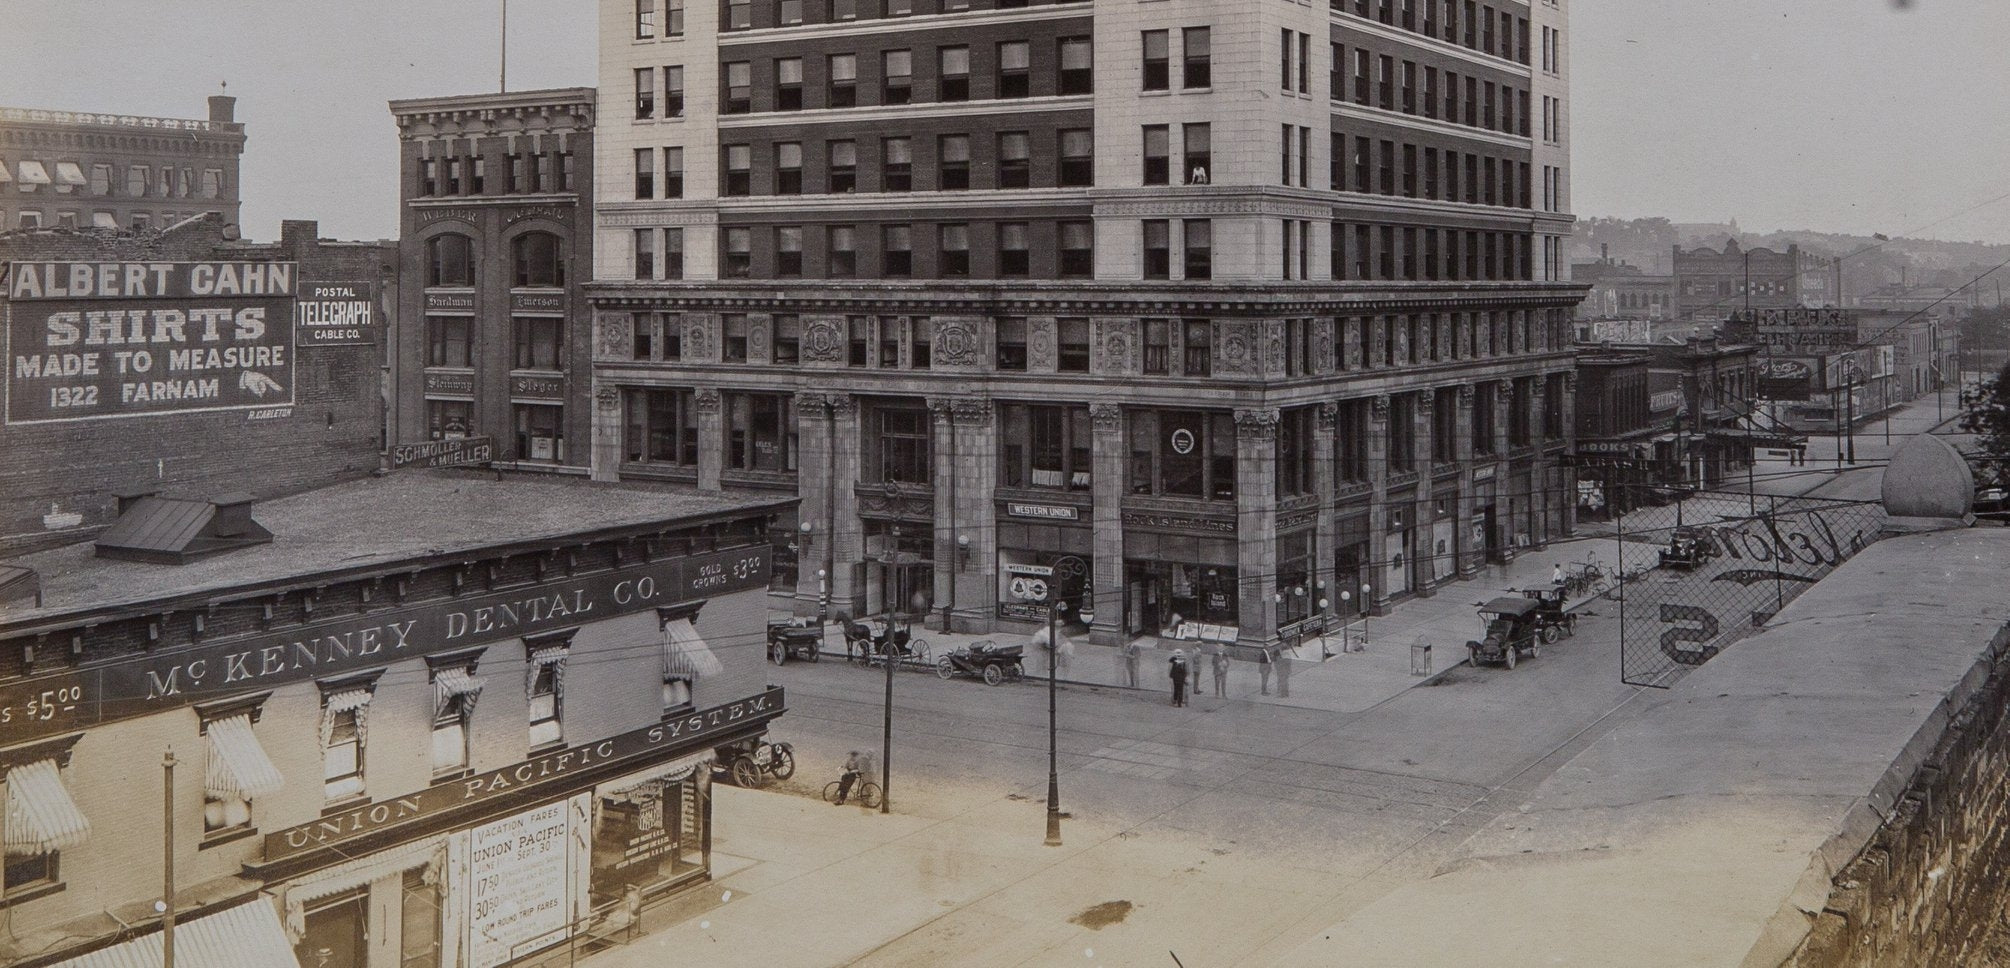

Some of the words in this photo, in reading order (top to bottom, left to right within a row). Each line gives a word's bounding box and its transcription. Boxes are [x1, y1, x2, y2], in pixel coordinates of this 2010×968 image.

[13, 263, 173, 298] ALBERT
[190, 263, 290, 296] CAHN
[314, 287, 356, 297] POSTAL
[299, 301, 372, 326] TELEGRAPH
[47, 307, 266, 346] SHIRTS
[314, 330, 344, 340] CABLE
[346, 330, 361, 340] CO.
[15, 353, 99, 379] MADE
[114, 351, 152, 374] TO
[169, 346, 285, 371] MEASURE
[50, 386, 99, 408] 1322
[121, 379, 219, 403] FARNAM
[395, 441, 462, 465] SCHMOLLER
[438, 444, 490, 465] MUELLER
[1014, 505, 1048, 516] WESTERN
[1050, 507, 1071, 517] UNION
[693, 573, 727, 588] CROWNS
[700, 563, 722, 577] GOLD
[446, 589, 593, 639] DENTAL
[614, 576, 660, 605] CO.
[285, 795, 422, 848] UNION
[463, 740, 614, 799] PACIFIC
[648, 697, 773, 744] SYSTEM.
[478, 819, 525, 845] VACATION
[530, 807, 559, 824] FARES
[473, 840, 513, 863] UNION
[519, 823, 565, 849] PACIFIC
[539, 840, 551, 853] 30
[519, 907, 535, 919] TRIP
[537, 898, 559, 913] FARES
